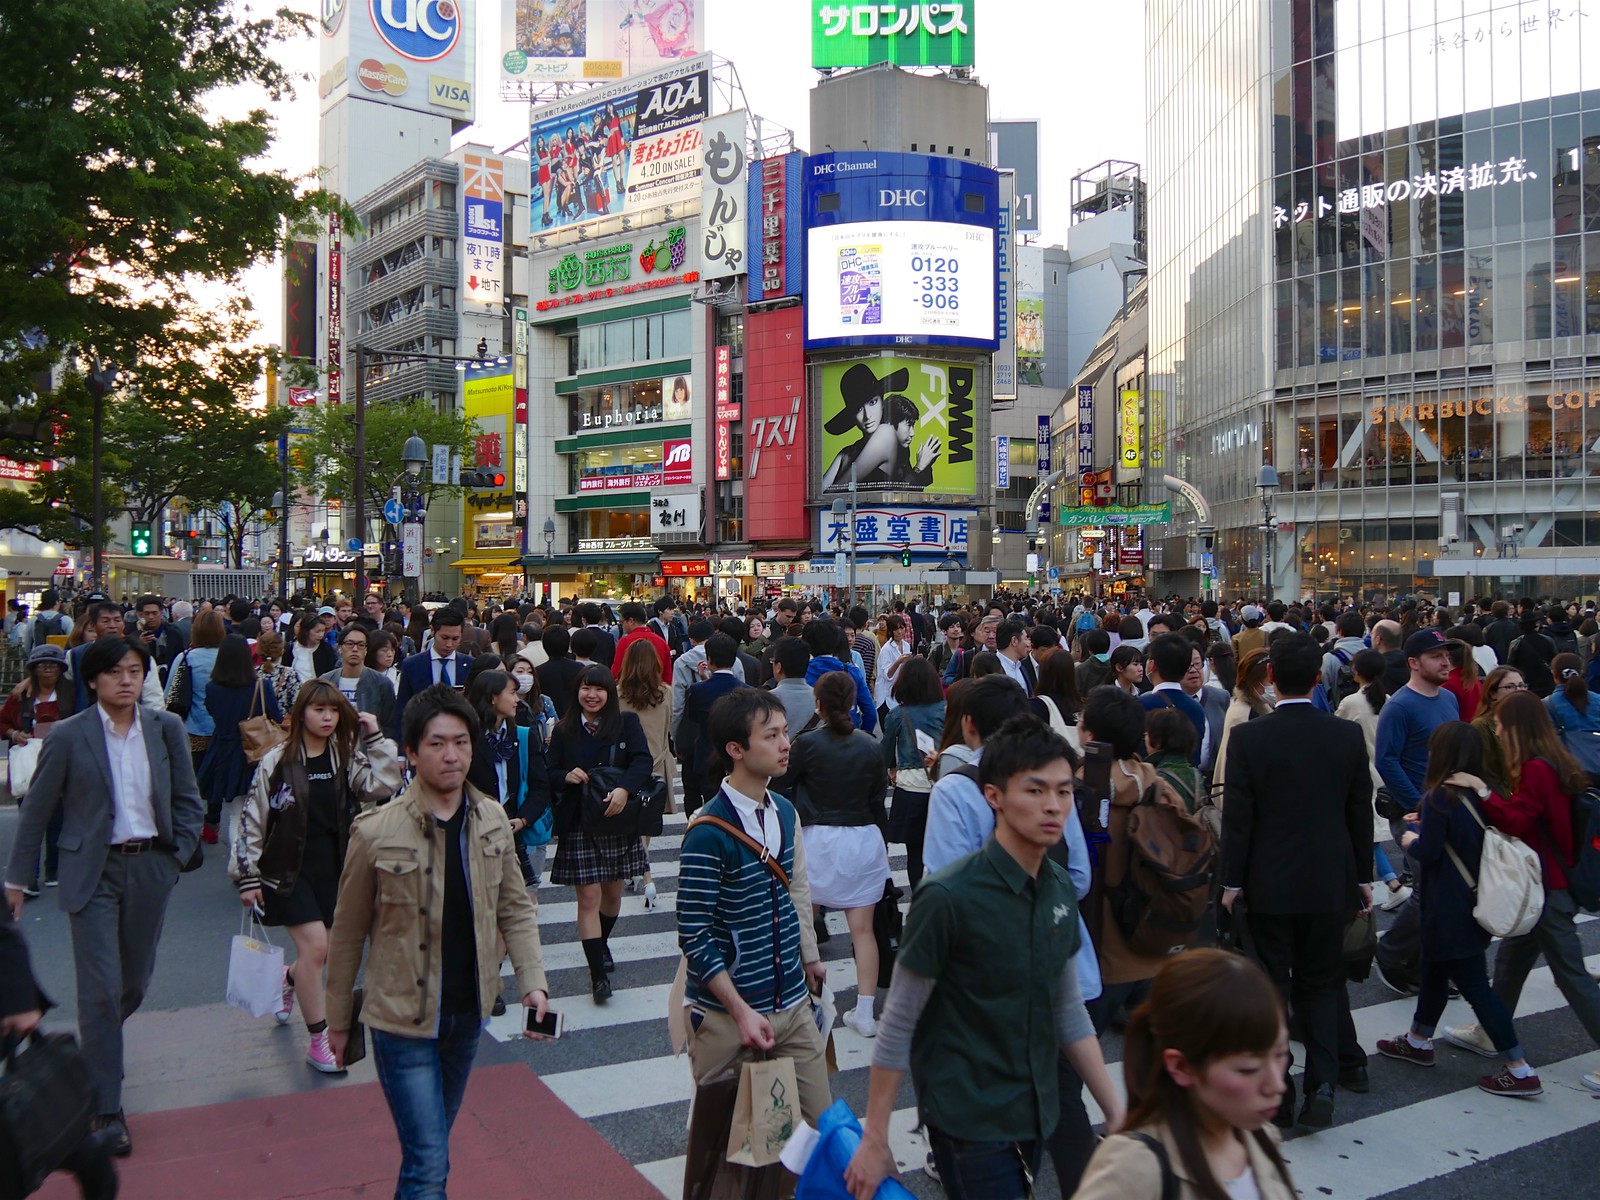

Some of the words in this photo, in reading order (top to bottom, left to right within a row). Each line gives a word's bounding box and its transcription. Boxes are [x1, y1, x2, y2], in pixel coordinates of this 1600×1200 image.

[819, 4, 968, 37] サロンパス
[1429, 8, 1589, 56] 渋谷から世界へ
[359, 66, 408, 87] MasterCard
[434, 83, 471, 104] VISA
[639, 75, 703, 121] AOA
[641, 161, 661, 178] 4.20
[662, 162, 674, 173] ON
[813, 163, 836, 176] DHC
[837, 160, 878, 173] Channel
[703, 130, 743, 272] もんじゃ
[879, 189, 927, 207] DHC
[965, 231, 985, 243] DHC
[466, 243, 501, 259] 夜11時
[472, 258, 494, 273] まで
[584, 254, 631, 287] 西村
[841, 256, 863, 270] DHC
[911, 256, 960, 274] 0120
[481, 278, 501, 292] 地下
[912, 276, 960, 292] -333
[912, 293, 960, 310] -906
[895, 335, 914, 344] DHC
[995, 371, 1012, 379] 3719
[467, 386, 497, 396] Matsumoto
[497, 384, 513, 394] KiYos
[920, 362, 947, 429] FX
[948, 366, 974, 465] DMM
[1369, 393, 1528, 425] STARBUCKS
[582, 407, 658, 430] Euphoria
[1079, 389, 1092, 467] 洋服の青山
[748, 395, 802, 480] クスリ
[475, 432, 502, 468] 薬
[665, 443, 692, 467] JTB
[1125, 450, 1136, 460] 4F
[606, 476, 631, 488] 海外旅行
[635, 474, 660, 482] ハネムーン
[1068, 513, 1106, 525] ガンバレ!
[827, 515, 968, 544] 大盛堂書店
[406, 527, 414, 572] 道玄坂
